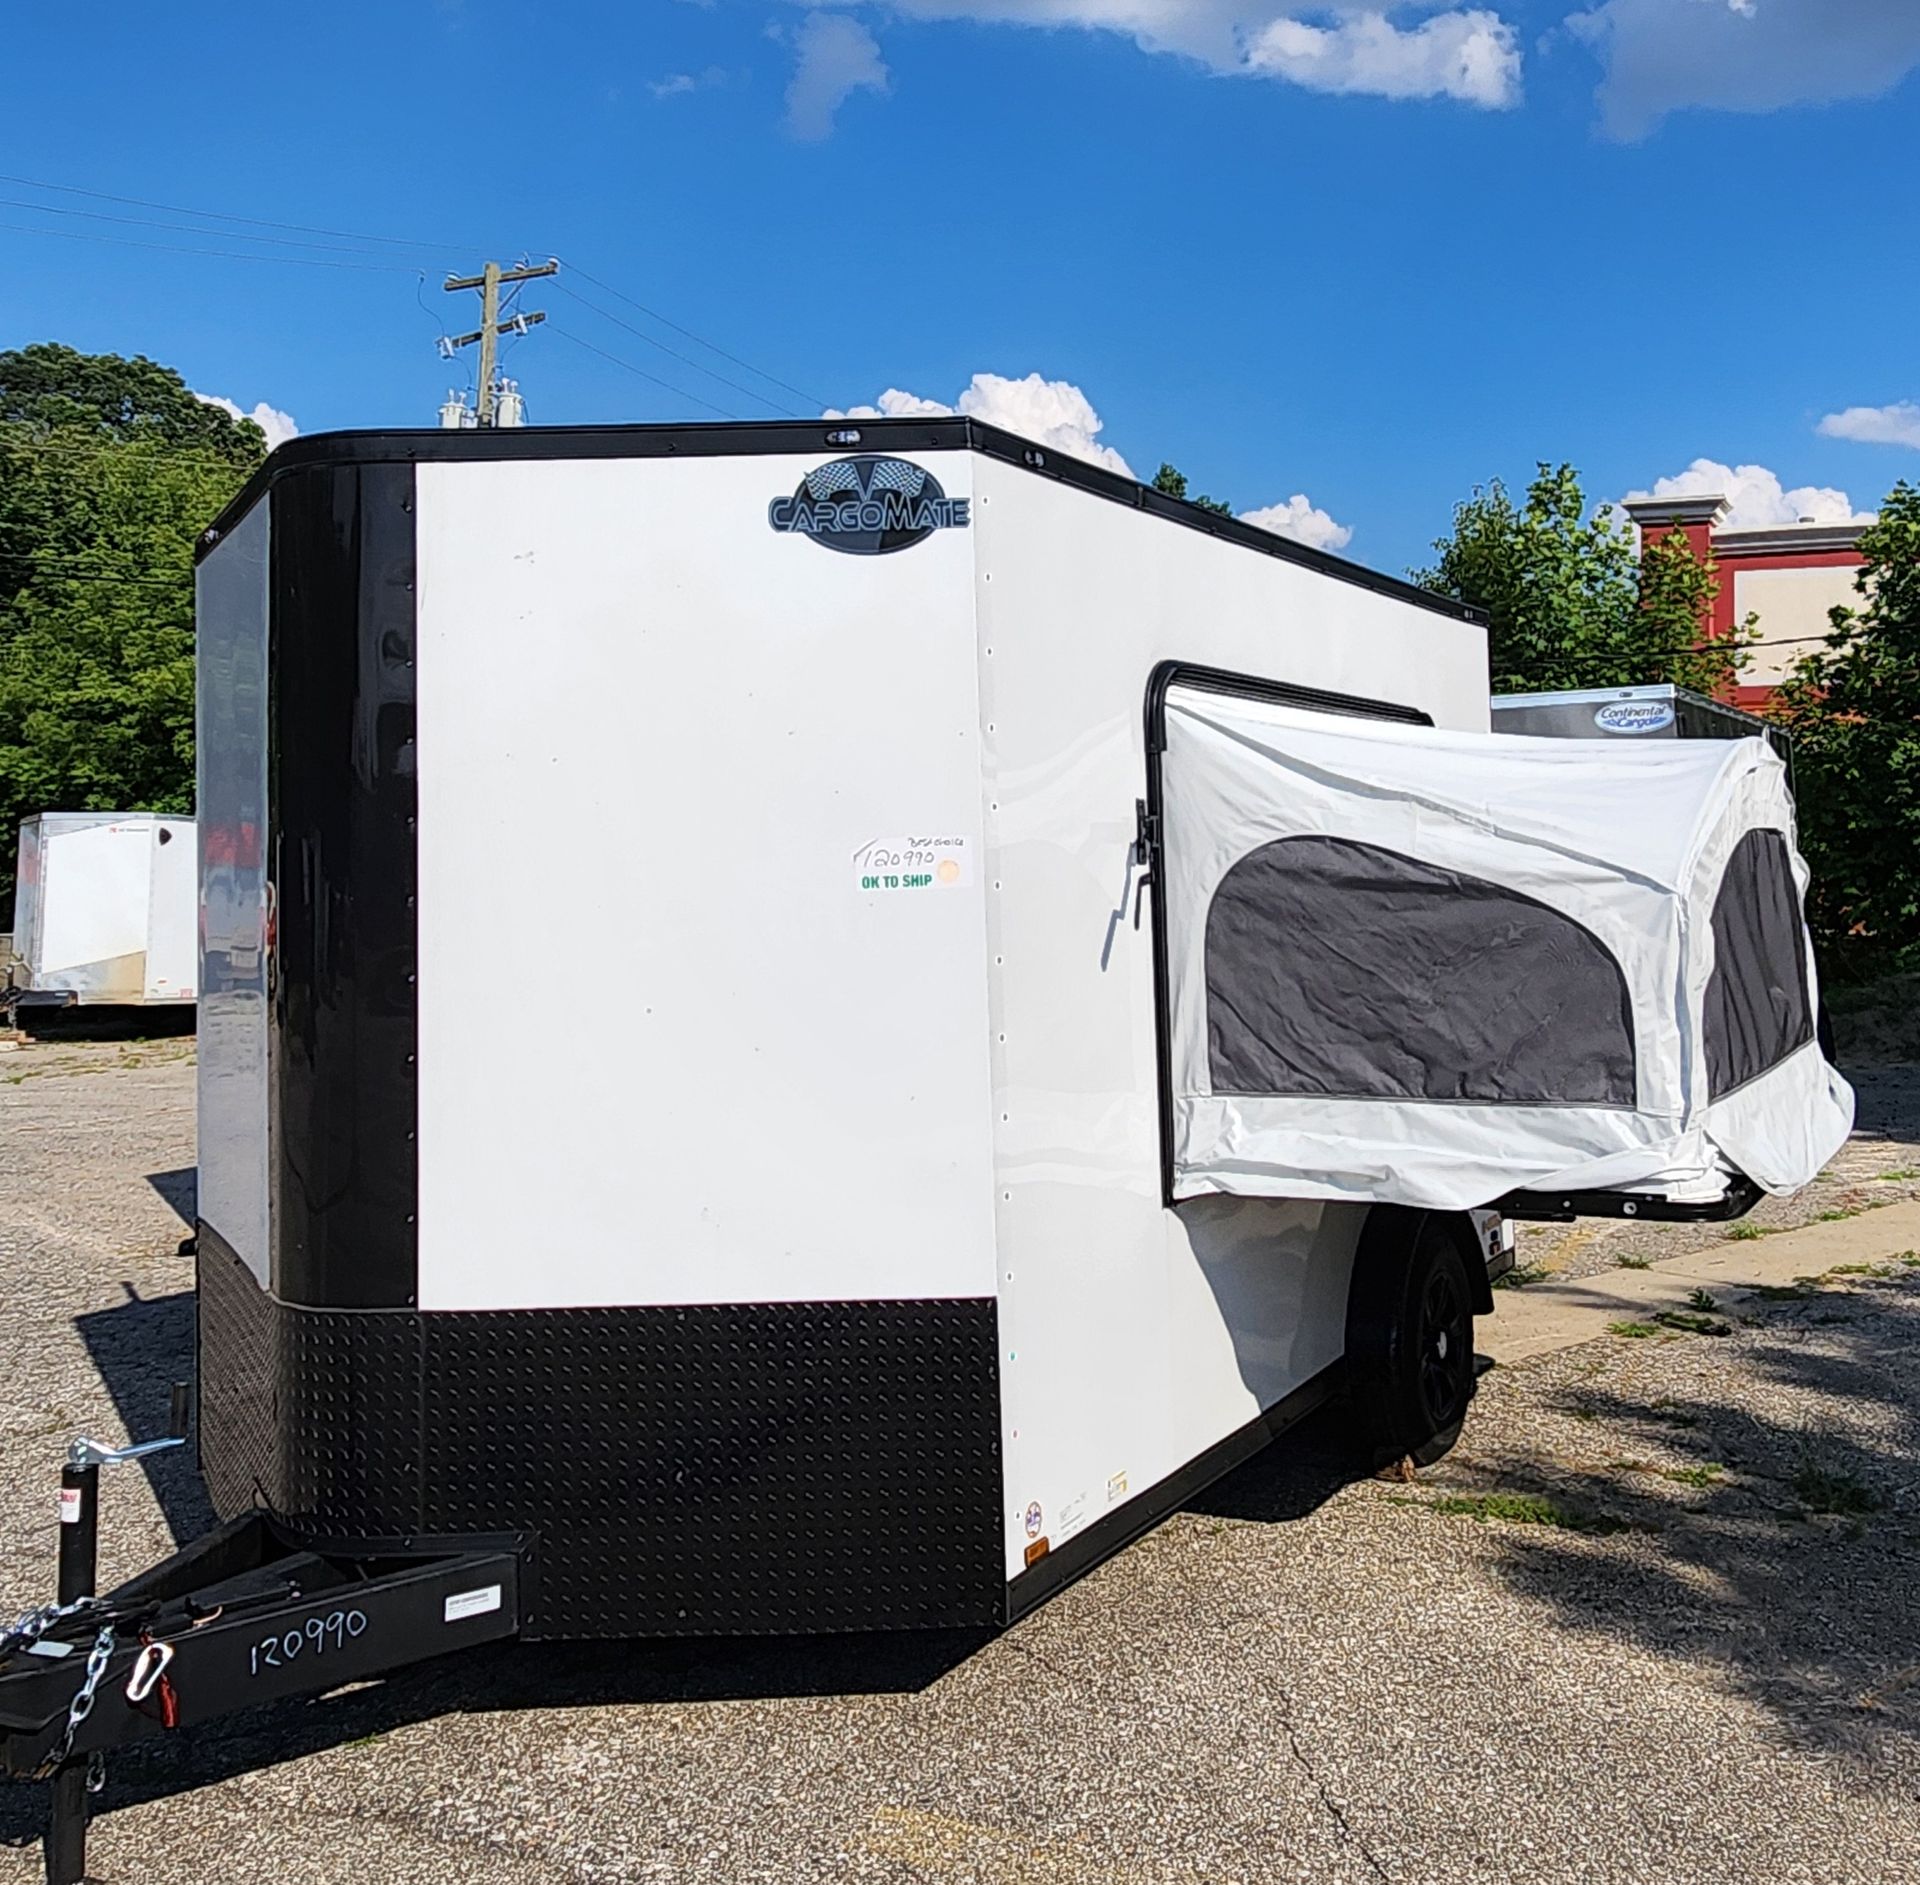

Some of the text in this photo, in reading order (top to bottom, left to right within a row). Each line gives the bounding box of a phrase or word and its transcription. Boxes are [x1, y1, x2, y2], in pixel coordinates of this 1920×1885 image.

[1601, 706, 1665, 719] Continental
[1617, 718, 1653, 728] Cargo
[863, 849, 935, 868] 120990
[862, 874, 932, 888] OK TO SHIP
[251, 1610, 366, 1675] 120990
